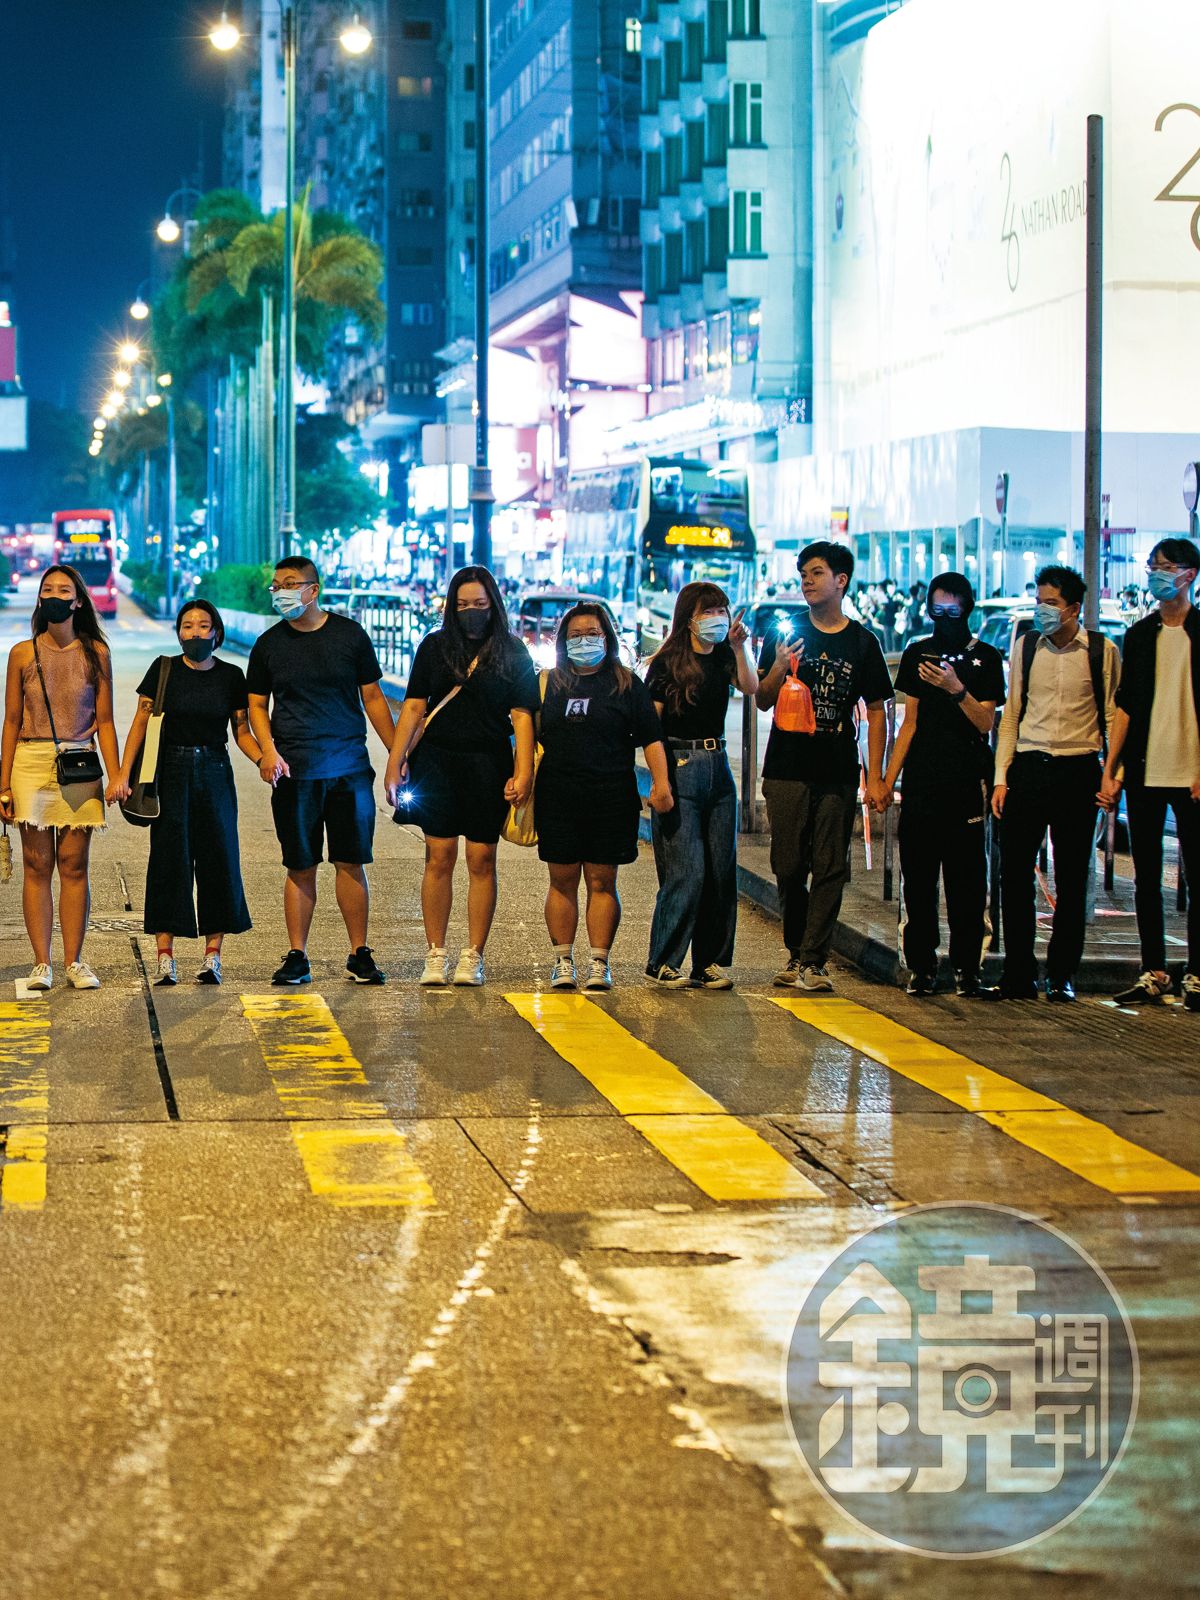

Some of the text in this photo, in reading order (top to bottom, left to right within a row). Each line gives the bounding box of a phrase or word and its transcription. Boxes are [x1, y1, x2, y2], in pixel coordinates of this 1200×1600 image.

[1021, 179, 1088, 236] NATHAN ROAD
[812, 683, 829, 698] AM
[813, 706, 837, 720] END
